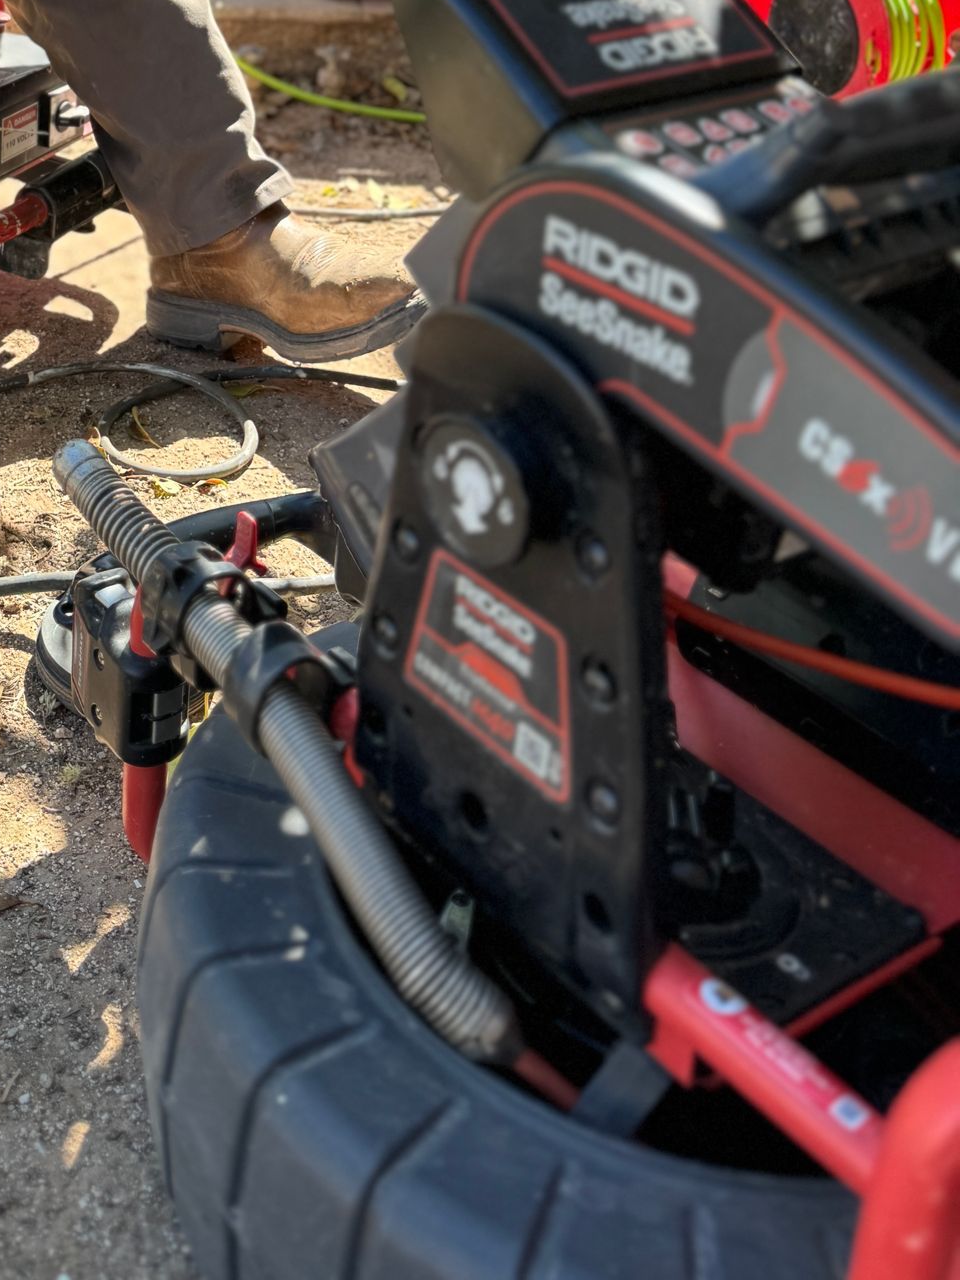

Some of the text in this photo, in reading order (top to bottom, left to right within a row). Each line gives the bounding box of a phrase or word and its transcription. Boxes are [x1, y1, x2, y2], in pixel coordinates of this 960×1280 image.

[598, 26, 717, 70] RIDGID
[543, 213, 701, 319] RIDGID
[539, 271, 693, 386] SeeSnake
